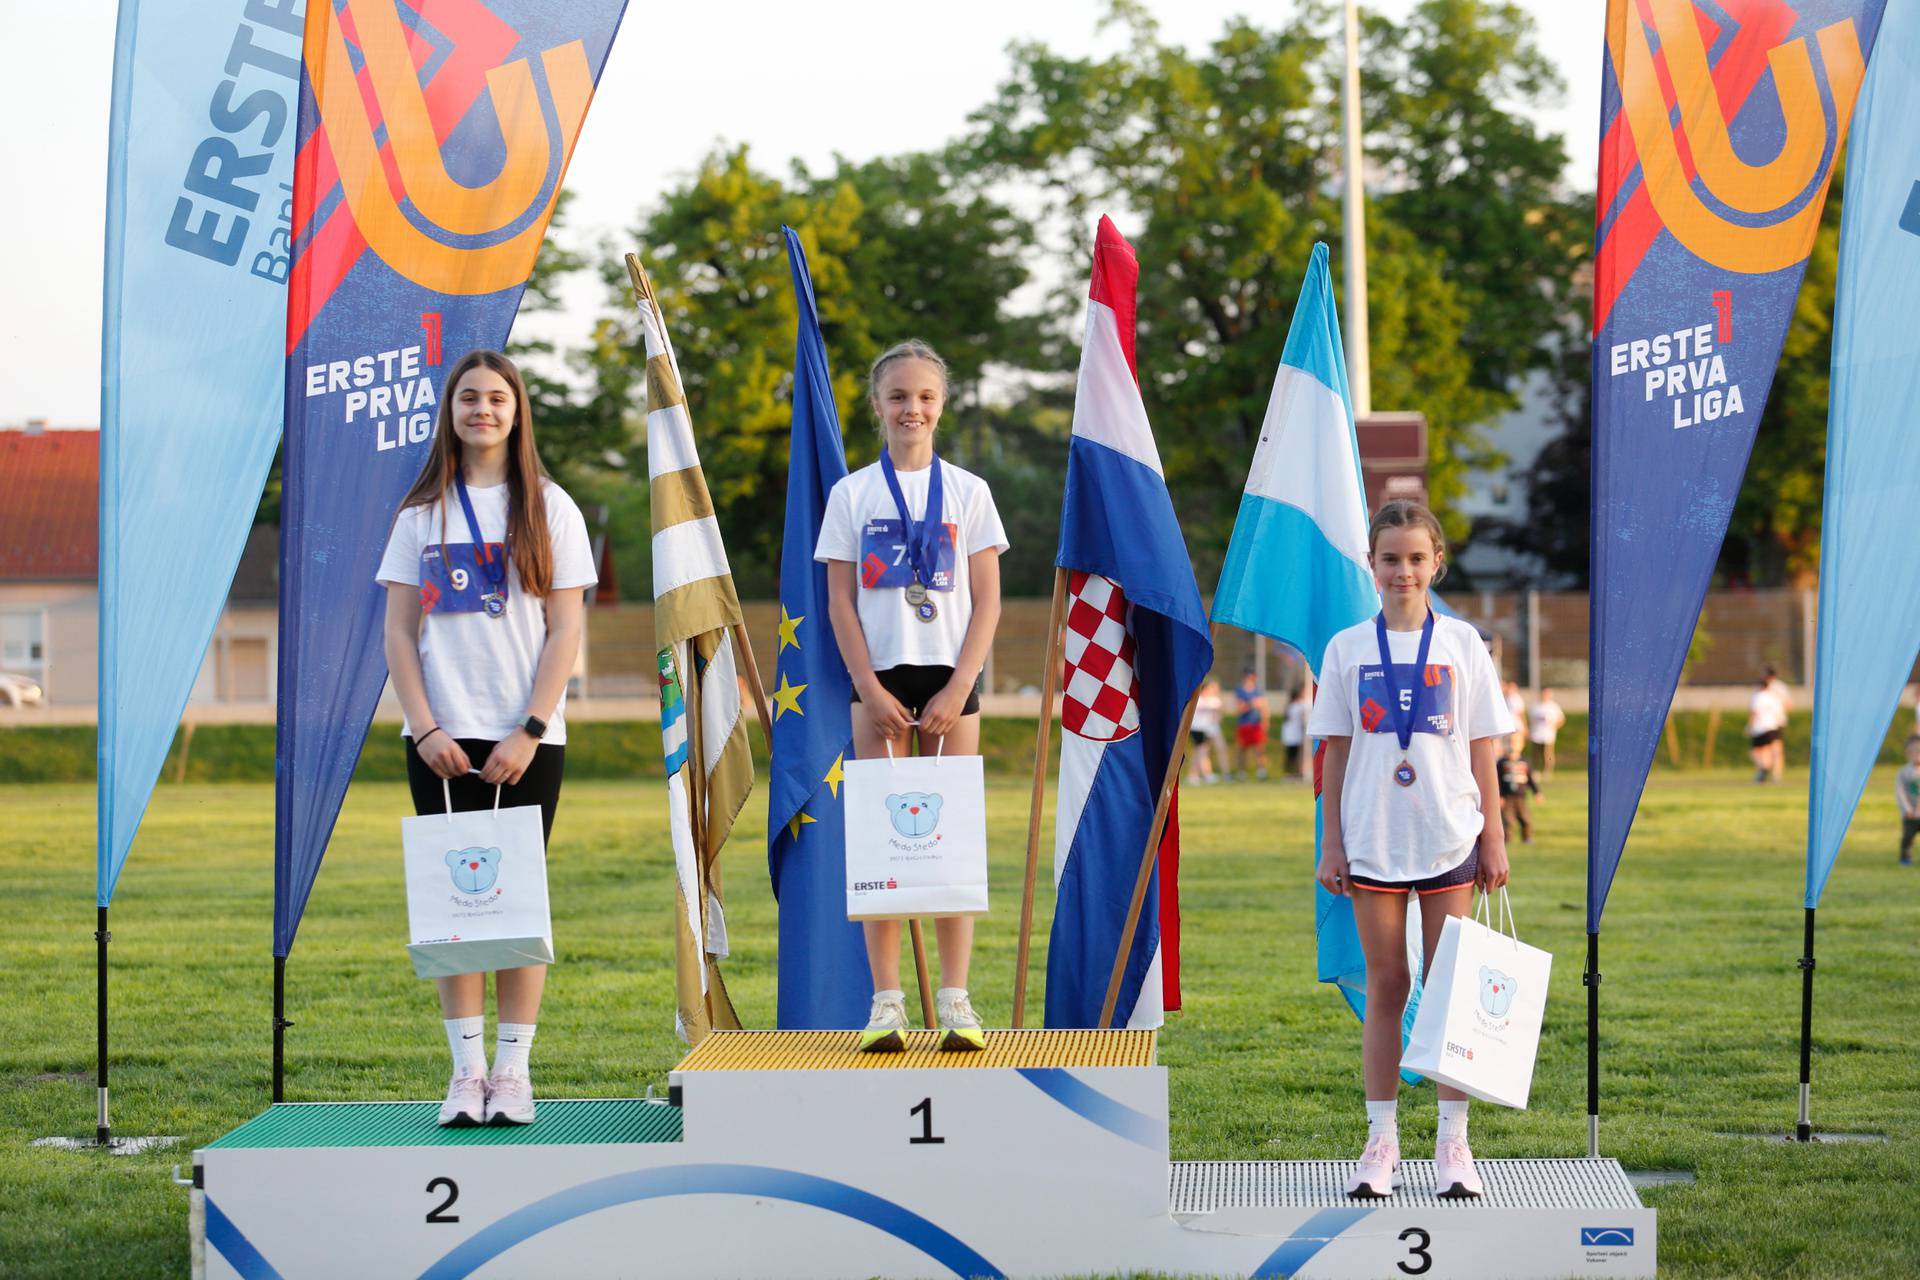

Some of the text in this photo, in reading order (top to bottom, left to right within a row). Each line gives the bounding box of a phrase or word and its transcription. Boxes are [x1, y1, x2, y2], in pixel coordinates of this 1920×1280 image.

[306, 345, 421, 397] ERSTE
[1611, 323, 1713, 377] ERSTE
[345, 377, 437, 423] PRVA
[1645, 354, 1727, 402] PRVA
[1674, 384, 1745, 429] LIGA
[377, 412, 440, 451] LIG
[452, 568, 469, 590] 9
[1400, 689, 1412, 710] 5
[854, 881, 885, 891] ERSTE
[1447, 1041, 1467, 1058] ERSTE
[910, 1097, 945, 1144] 1
[426, 1176, 460, 1223] 2
[1396, 1226, 1432, 1275] 3
